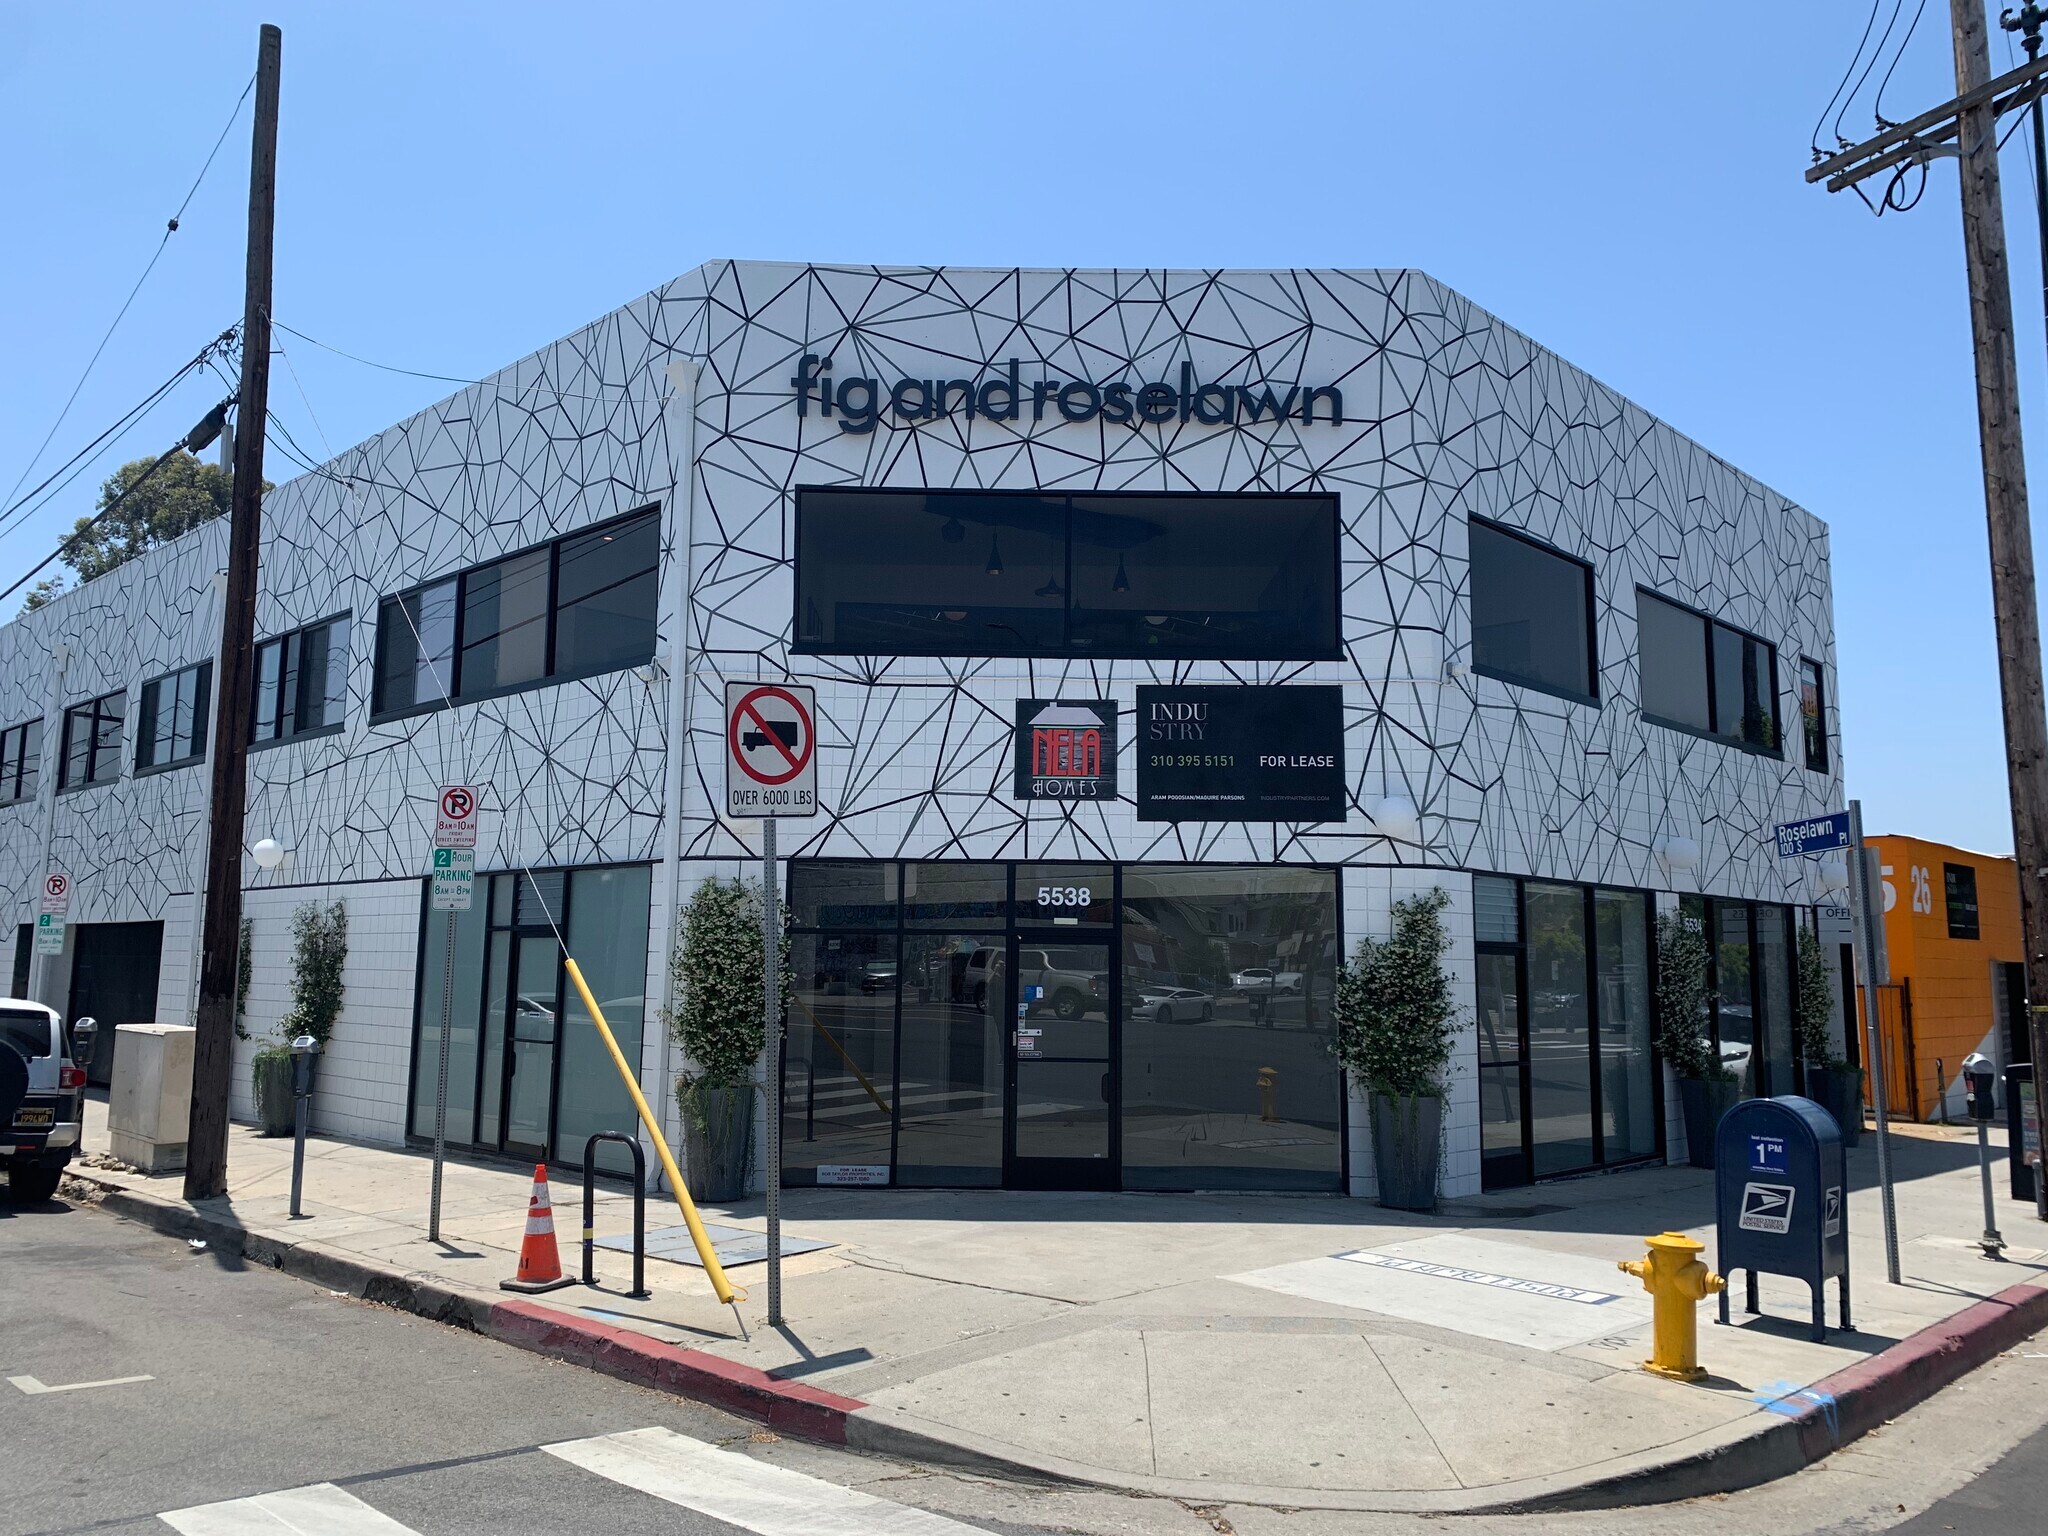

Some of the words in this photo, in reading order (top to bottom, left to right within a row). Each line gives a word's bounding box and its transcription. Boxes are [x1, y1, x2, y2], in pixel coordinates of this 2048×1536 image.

[790, 354, 879, 434] fig
[891, 357, 1020, 421] and
[1032, 360, 1344, 427] roselawn
[1150, 703, 1208, 721] INDU
[1150, 723, 1208, 741] STRY
[1032, 729, 1101, 776] NELA
[1151, 755, 1173, 767] 310
[1177, 755, 1200, 767] 395
[1204, 755, 1234, 767] 5151
[1260, 755, 1286, 767] FOR
[1291, 755, 1334, 767] LEASE
[1032, 780, 1097, 797] HOMES
[733, 790, 758, 805] OVER
[763, 790, 789, 805] 6000
[793, 790, 812, 805] LBS
[438, 821, 452, 830] 8AM
[457, 821, 474, 830] 10AM
[1778, 820, 1834, 843] Roselawn
[1838, 832, 1848, 845] Pl
[1780, 842, 1794, 855] 100
[1796, 840, 1803, 852] S
[438, 851, 447, 865] 2
[452, 851, 472, 862] HOUR
[435, 869, 472, 881] PARKING
[434, 885, 449, 895] 8AM
[456, 885, 471, 895] 8PM
[1037, 887, 1091, 906] 5538
[1911, 865, 1931, 914] 26
[41, 916, 48, 925] 2
[39, 928, 63, 936] PARKING
[1756, 1143, 1765, 1163] 1
[1768, 1144, 1782, 1153] PM
[1763, 1223, 1785, 1231] SERVICE
